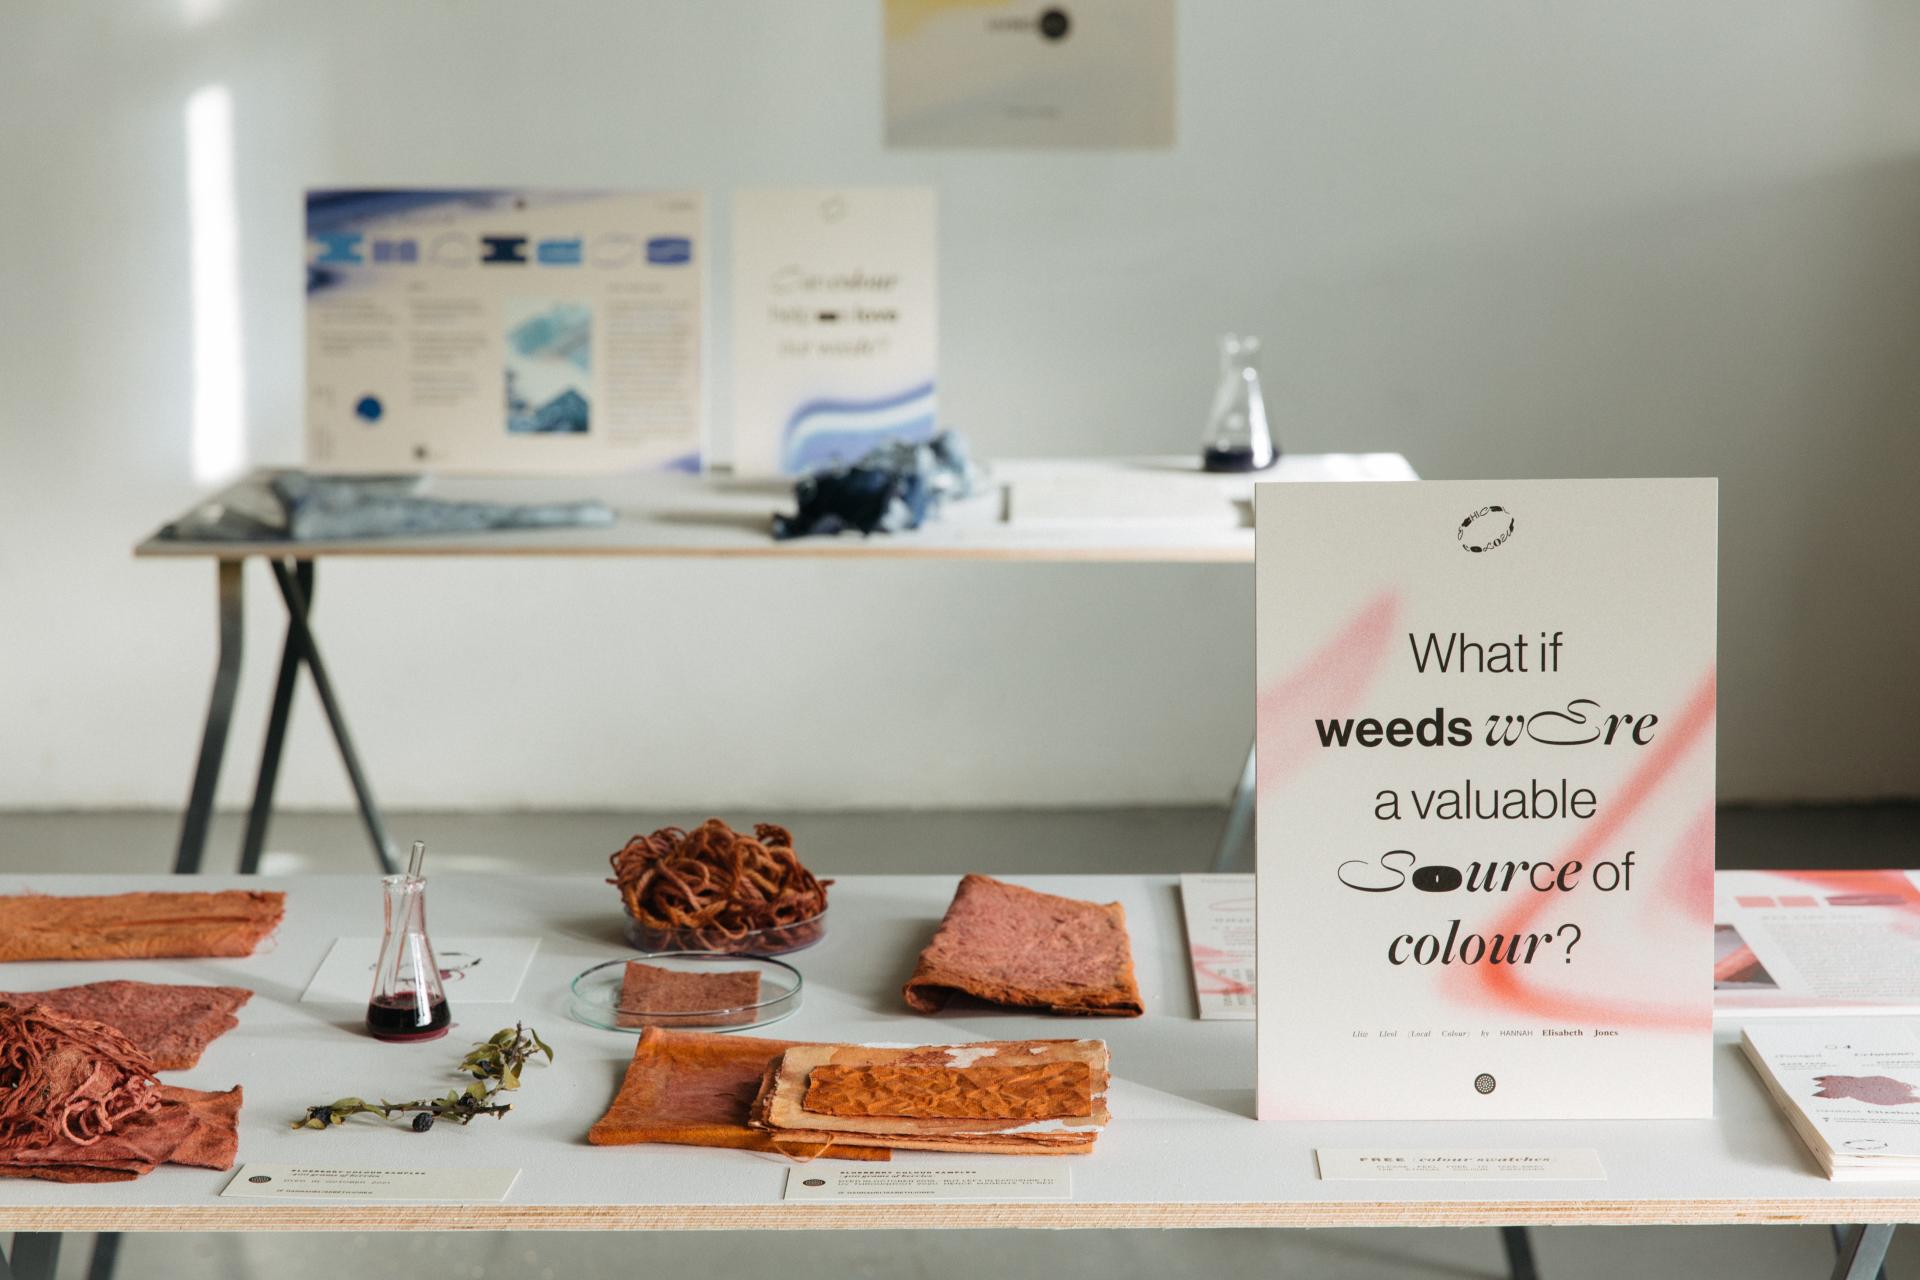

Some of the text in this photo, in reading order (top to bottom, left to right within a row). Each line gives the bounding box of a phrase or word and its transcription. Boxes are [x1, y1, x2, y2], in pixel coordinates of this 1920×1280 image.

[1409, 631, 1564, 673] What if
[1315, 707, 1473, 748] weeds
[1374, 778, 1598, 820] a valuable
[1337, 849, 1636, 893] Source of
[1387, 918, 1582, 966] colour?
[1499, 1029, 1534, 1037] HANNAH
[1541, 1028, 1584, 1037] Elisabeth
[1593, 1028, 1619, 1038] Jones
